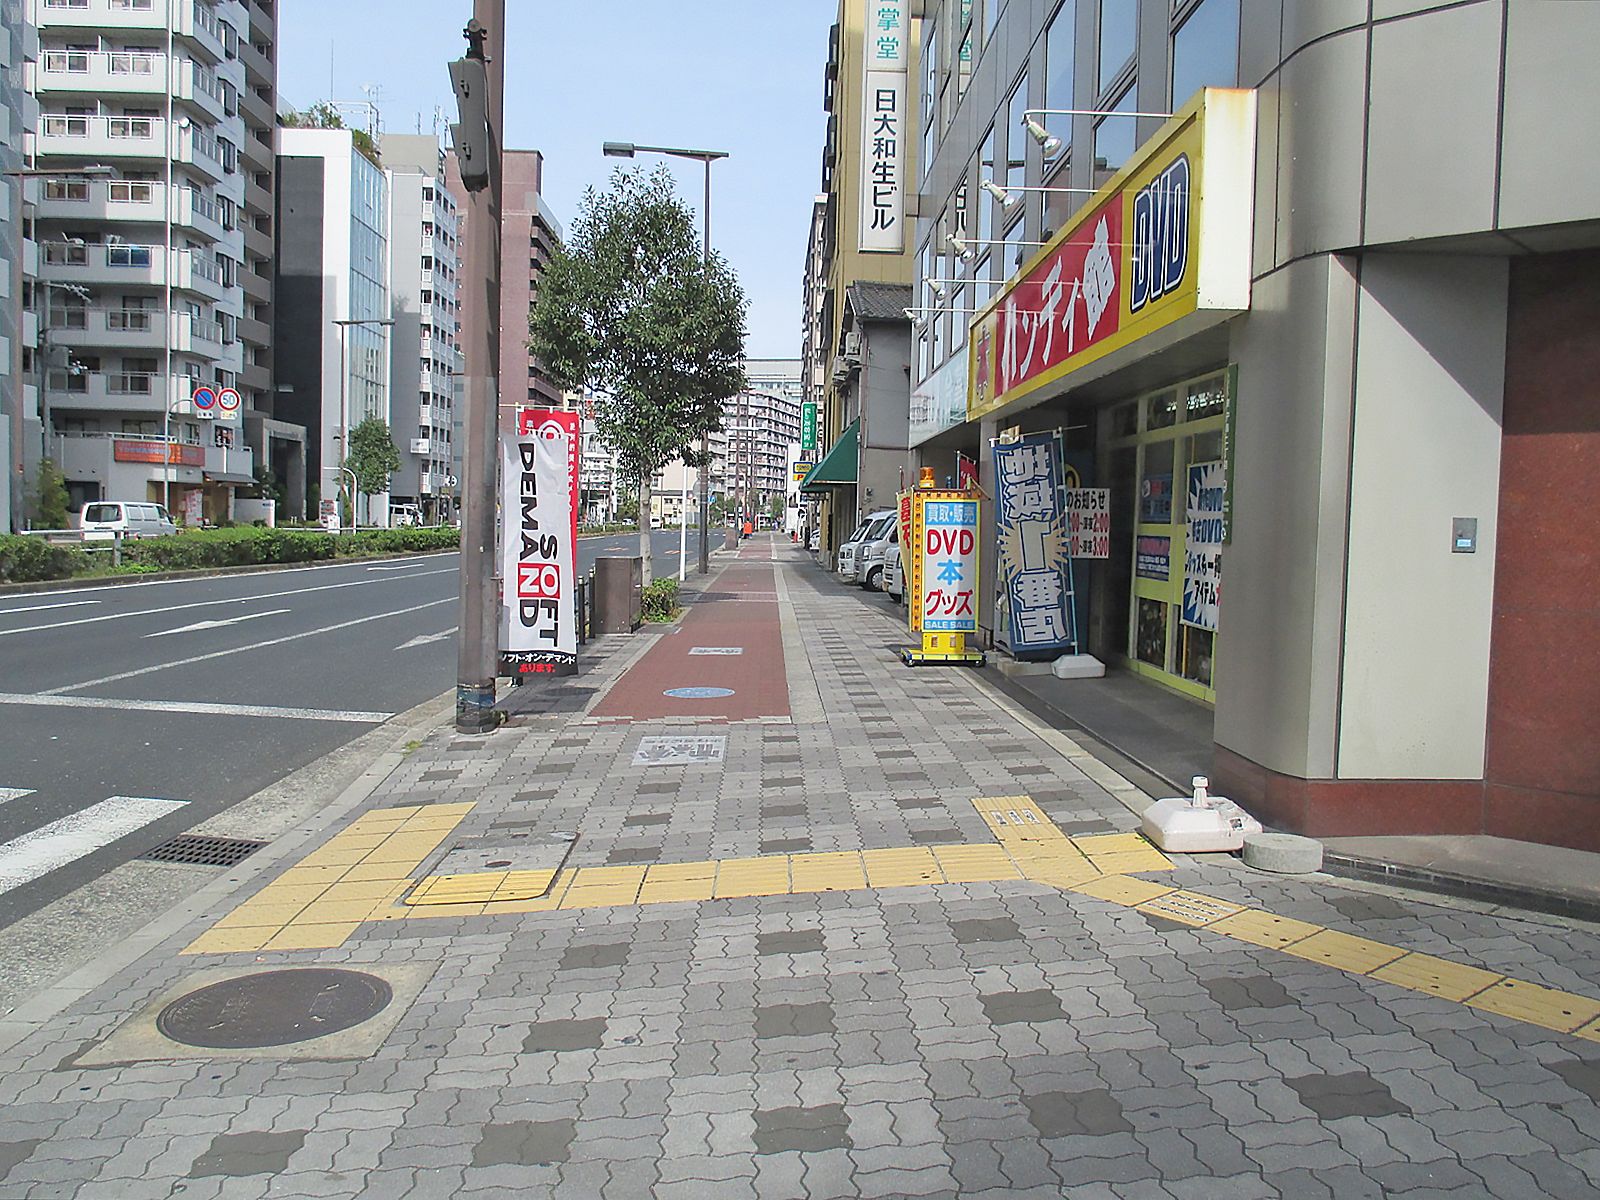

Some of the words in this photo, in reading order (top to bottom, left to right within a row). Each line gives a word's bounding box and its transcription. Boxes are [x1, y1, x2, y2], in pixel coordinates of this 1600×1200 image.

[876, 0, 900, 60] 掌堂
[870, 88, 897, 231] 日大和生ビル
[1130, 152, 1191, 315] DVD
[222, 394, 236, 405] 50
[927, 503, 975, 523] 買取・販売
[517, 442, 541, 628] DEMAND
[926, 529, 974, 556] DVD
[936, 558, 964, 586] 本
[539, 533, 561, 648] SOFT
[925, 589, 974, 617] グッズ
[925, 619, 949, 629] SALE
[950, 619, 975, 629] SALE
